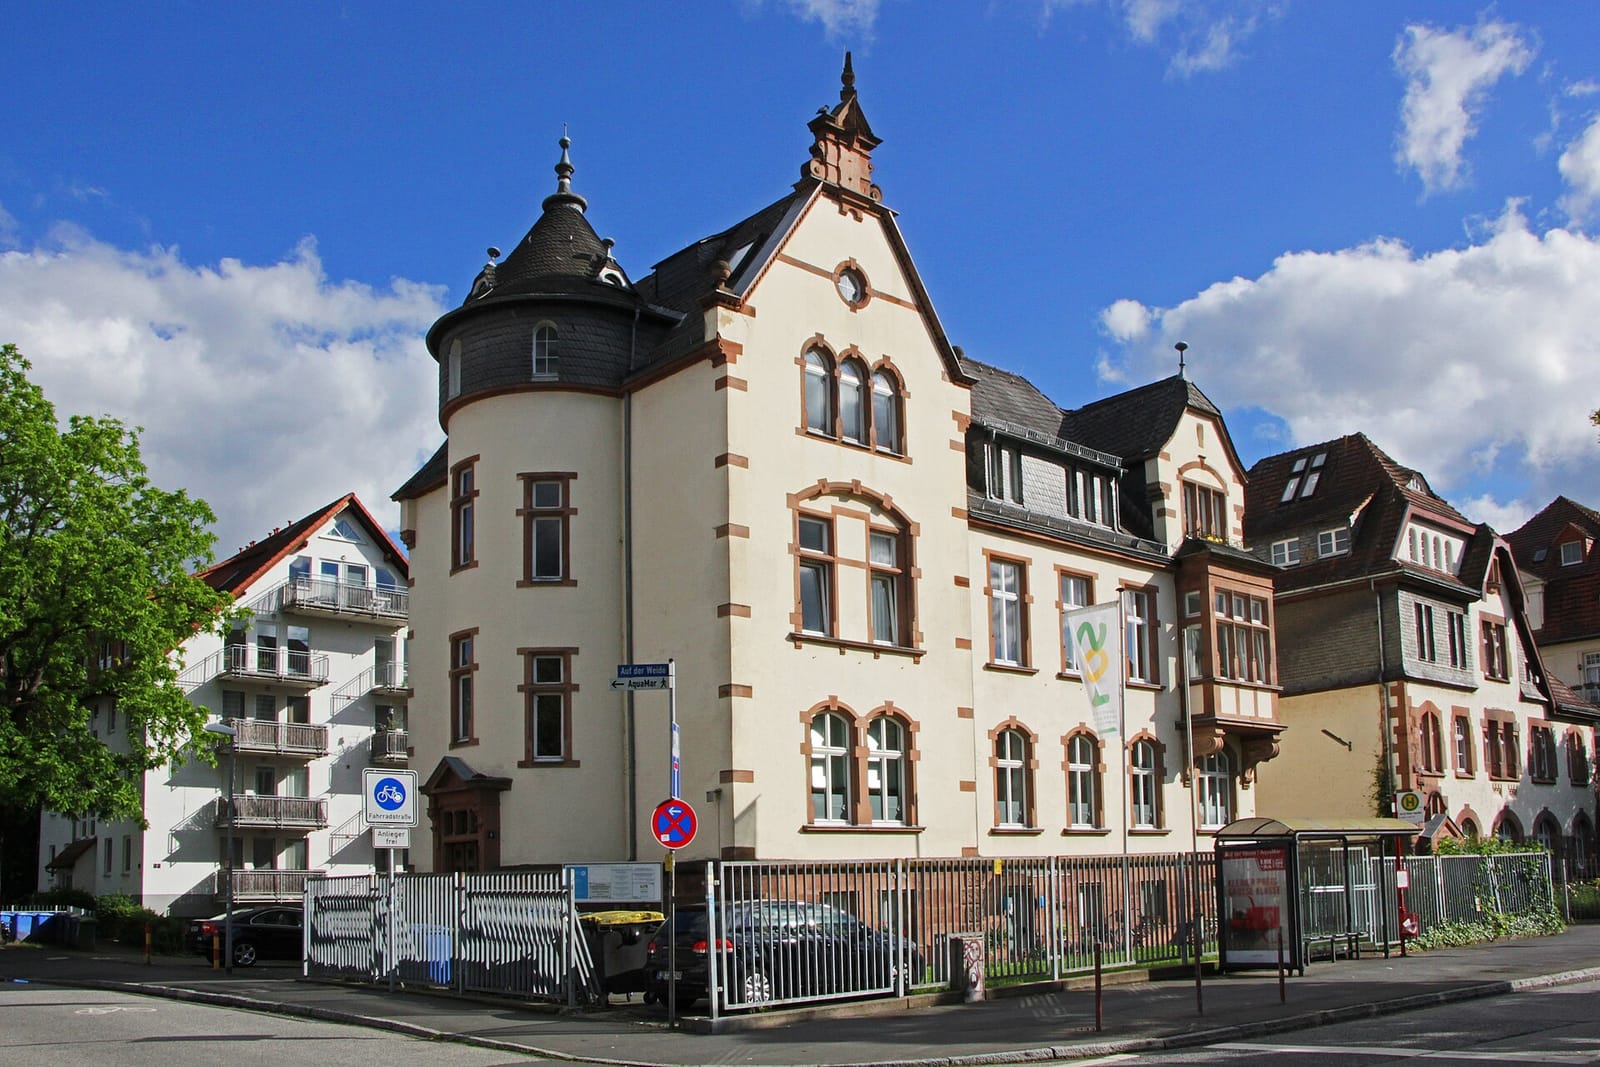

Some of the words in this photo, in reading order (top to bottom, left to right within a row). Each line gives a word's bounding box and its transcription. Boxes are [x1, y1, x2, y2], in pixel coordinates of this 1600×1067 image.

[620, 666, 632, 675] Auf
[633, 666, 644, 675] der
[646, 665, 667, 675] Weide
[628, 679, 657, 689] AquaMar
[368, 812, 411, 820] Fahrradstraße
[377, 831, 405, 839] Anlieger
